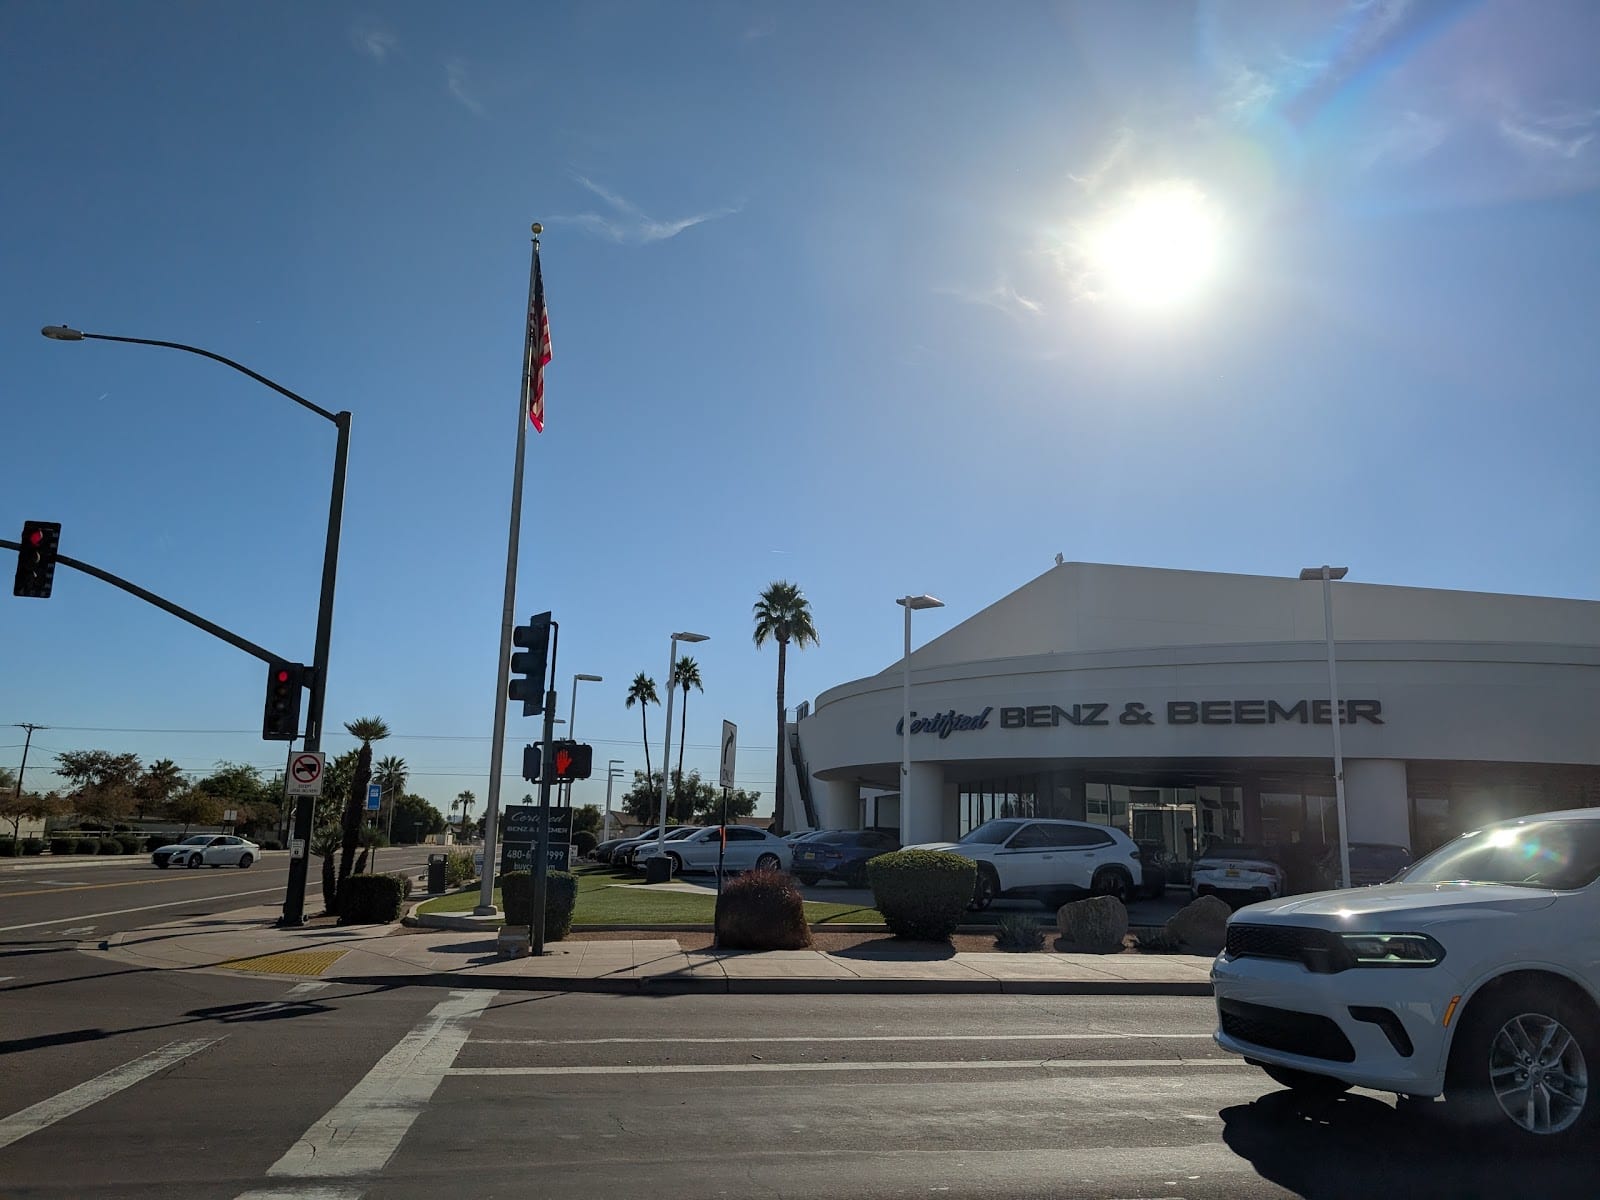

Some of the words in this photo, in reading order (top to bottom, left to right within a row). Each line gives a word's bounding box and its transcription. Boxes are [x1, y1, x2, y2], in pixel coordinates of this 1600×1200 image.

[896, 706, 993, 739] Certified
[1000, 703, 1109, 728] BENZ
[1119, 702, 1155, 725] &
[1167, 699, 1385, 724] BEEMER
[511, 811, 566, 824] Certied
